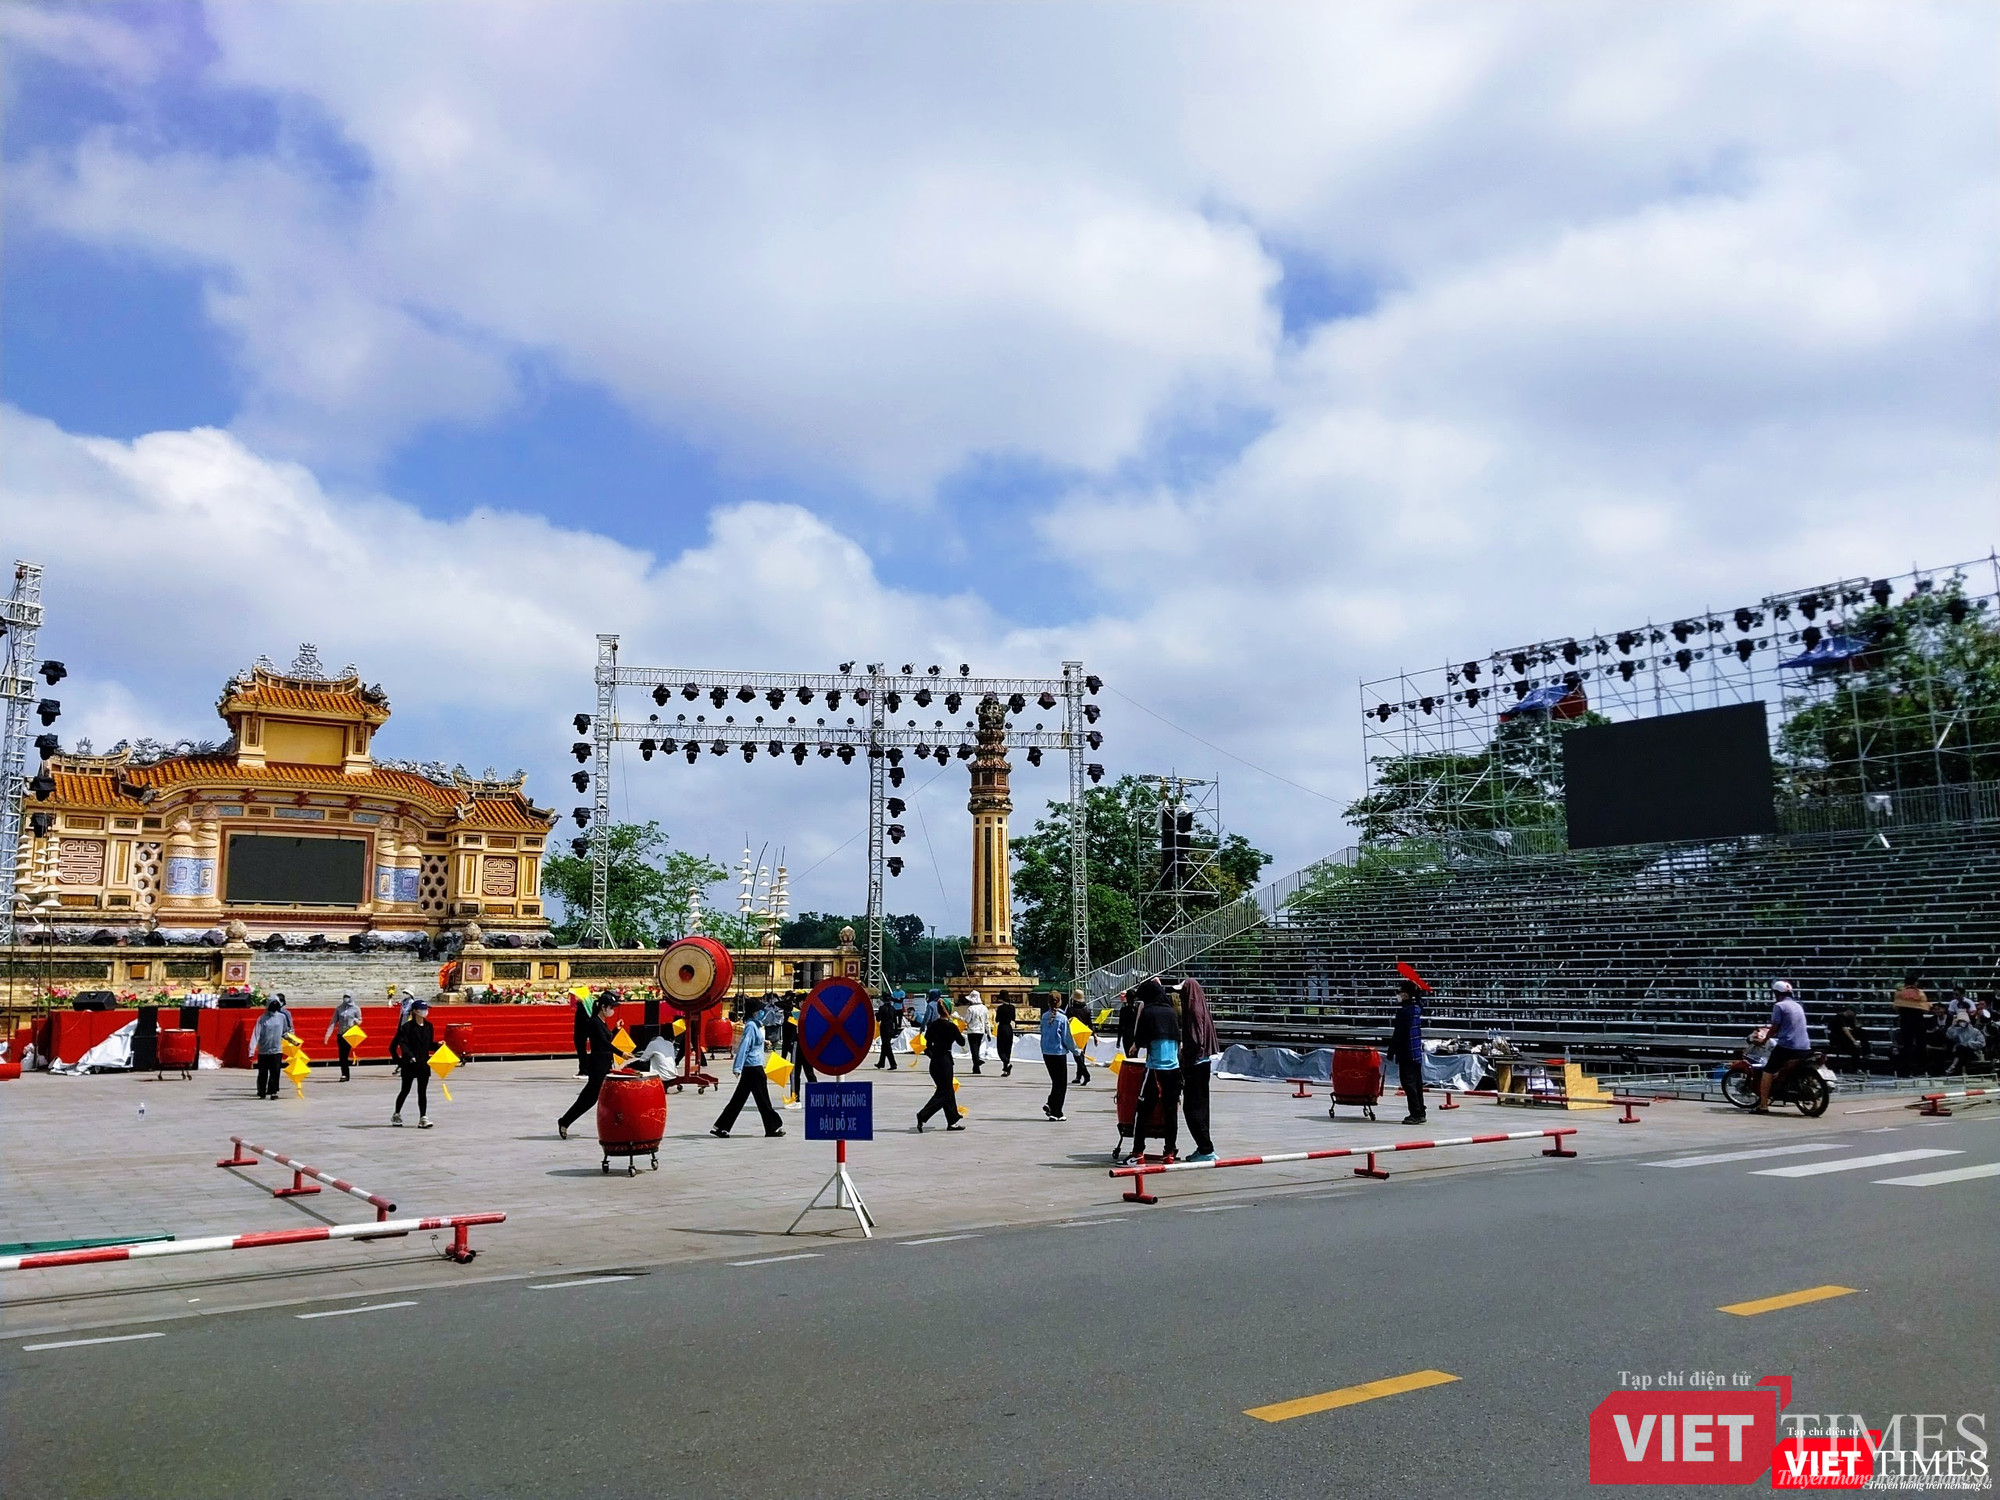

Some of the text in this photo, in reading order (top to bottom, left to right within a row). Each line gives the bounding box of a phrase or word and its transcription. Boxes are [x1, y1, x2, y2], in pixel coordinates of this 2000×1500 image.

[810, 1090, 866, 1110] KHU VỰC KHÔNG
[819, 1113, 834, 1134] ĐẬU
[847, 1117, 857, 1131] XE
